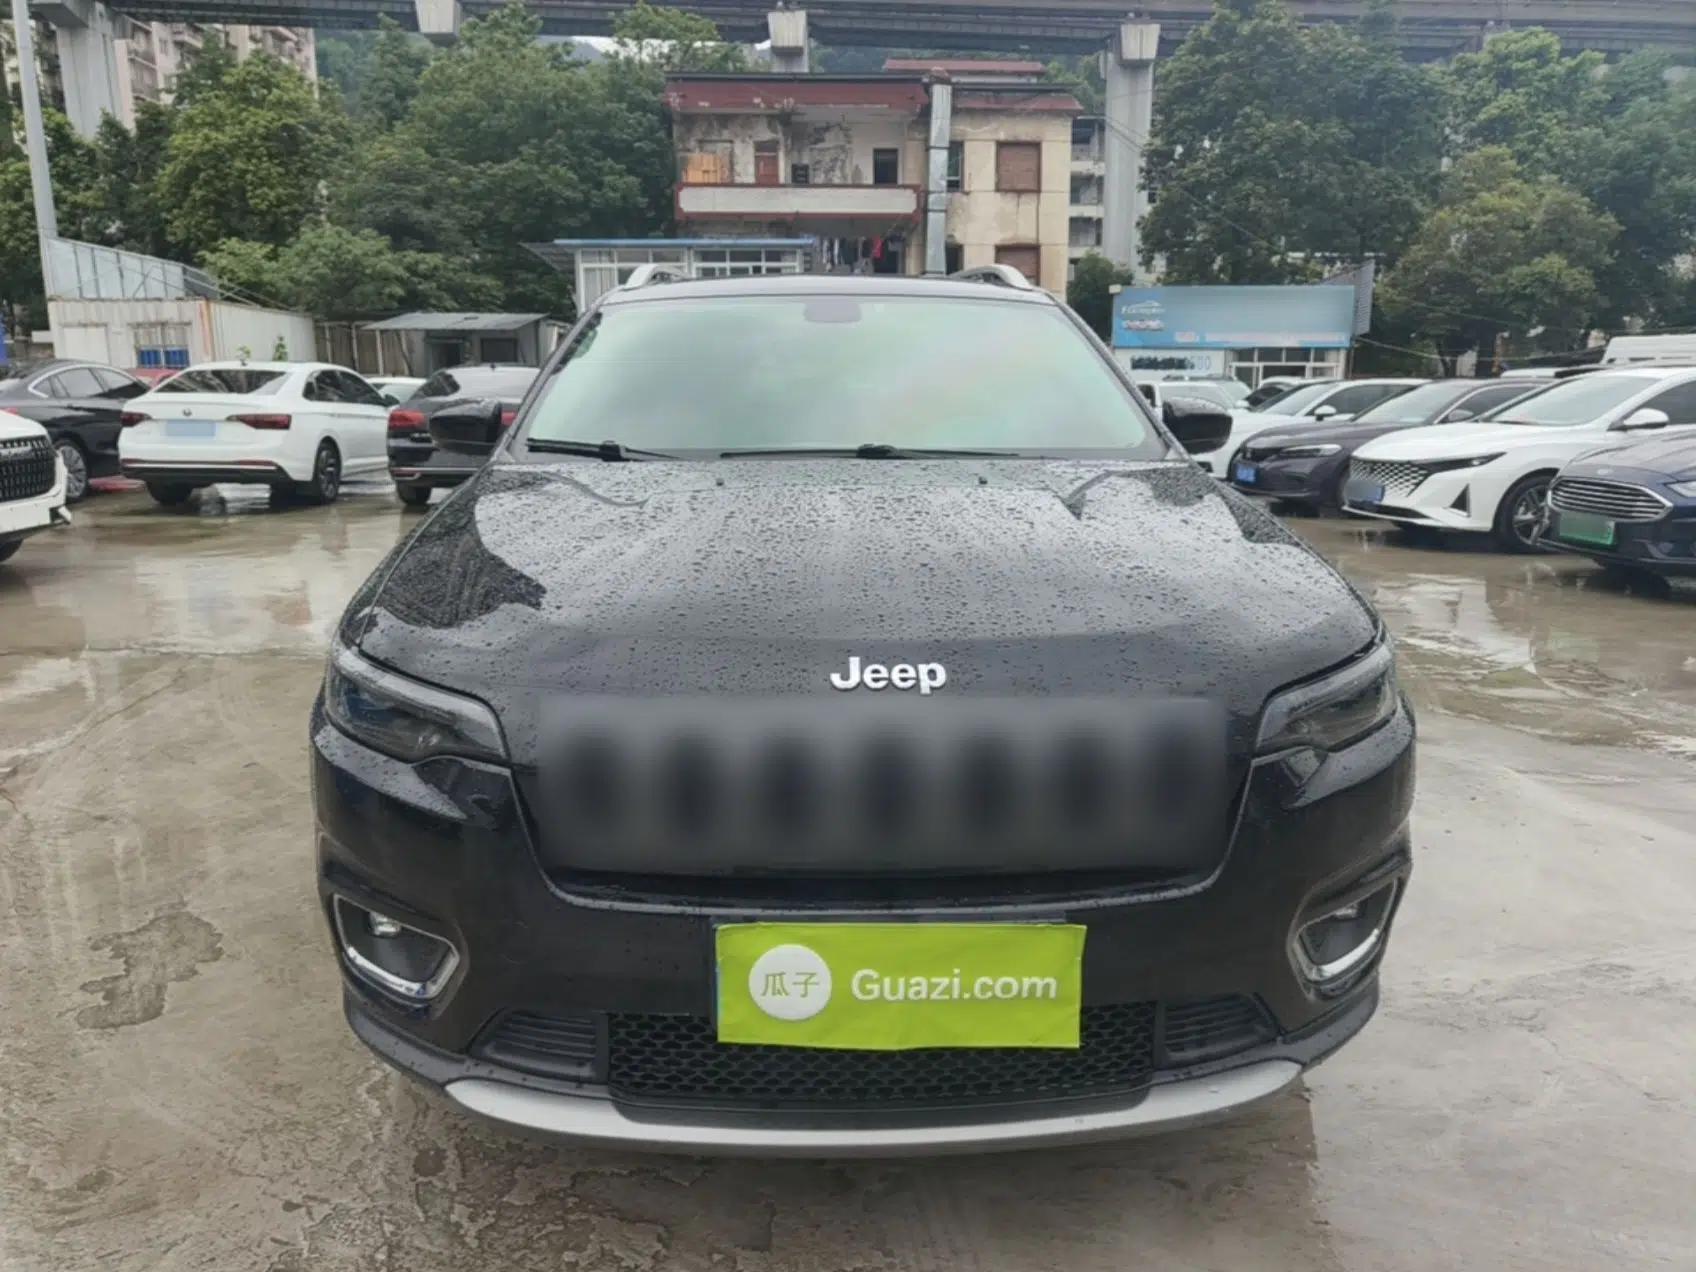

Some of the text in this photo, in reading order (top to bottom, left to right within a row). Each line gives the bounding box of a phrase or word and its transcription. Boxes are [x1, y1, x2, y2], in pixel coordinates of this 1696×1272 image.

[830, 657, 947, 695] Jeep
[761, 970, 820, 999] 瓜子
[851, 968, 1058, 1001] Guazi.com
